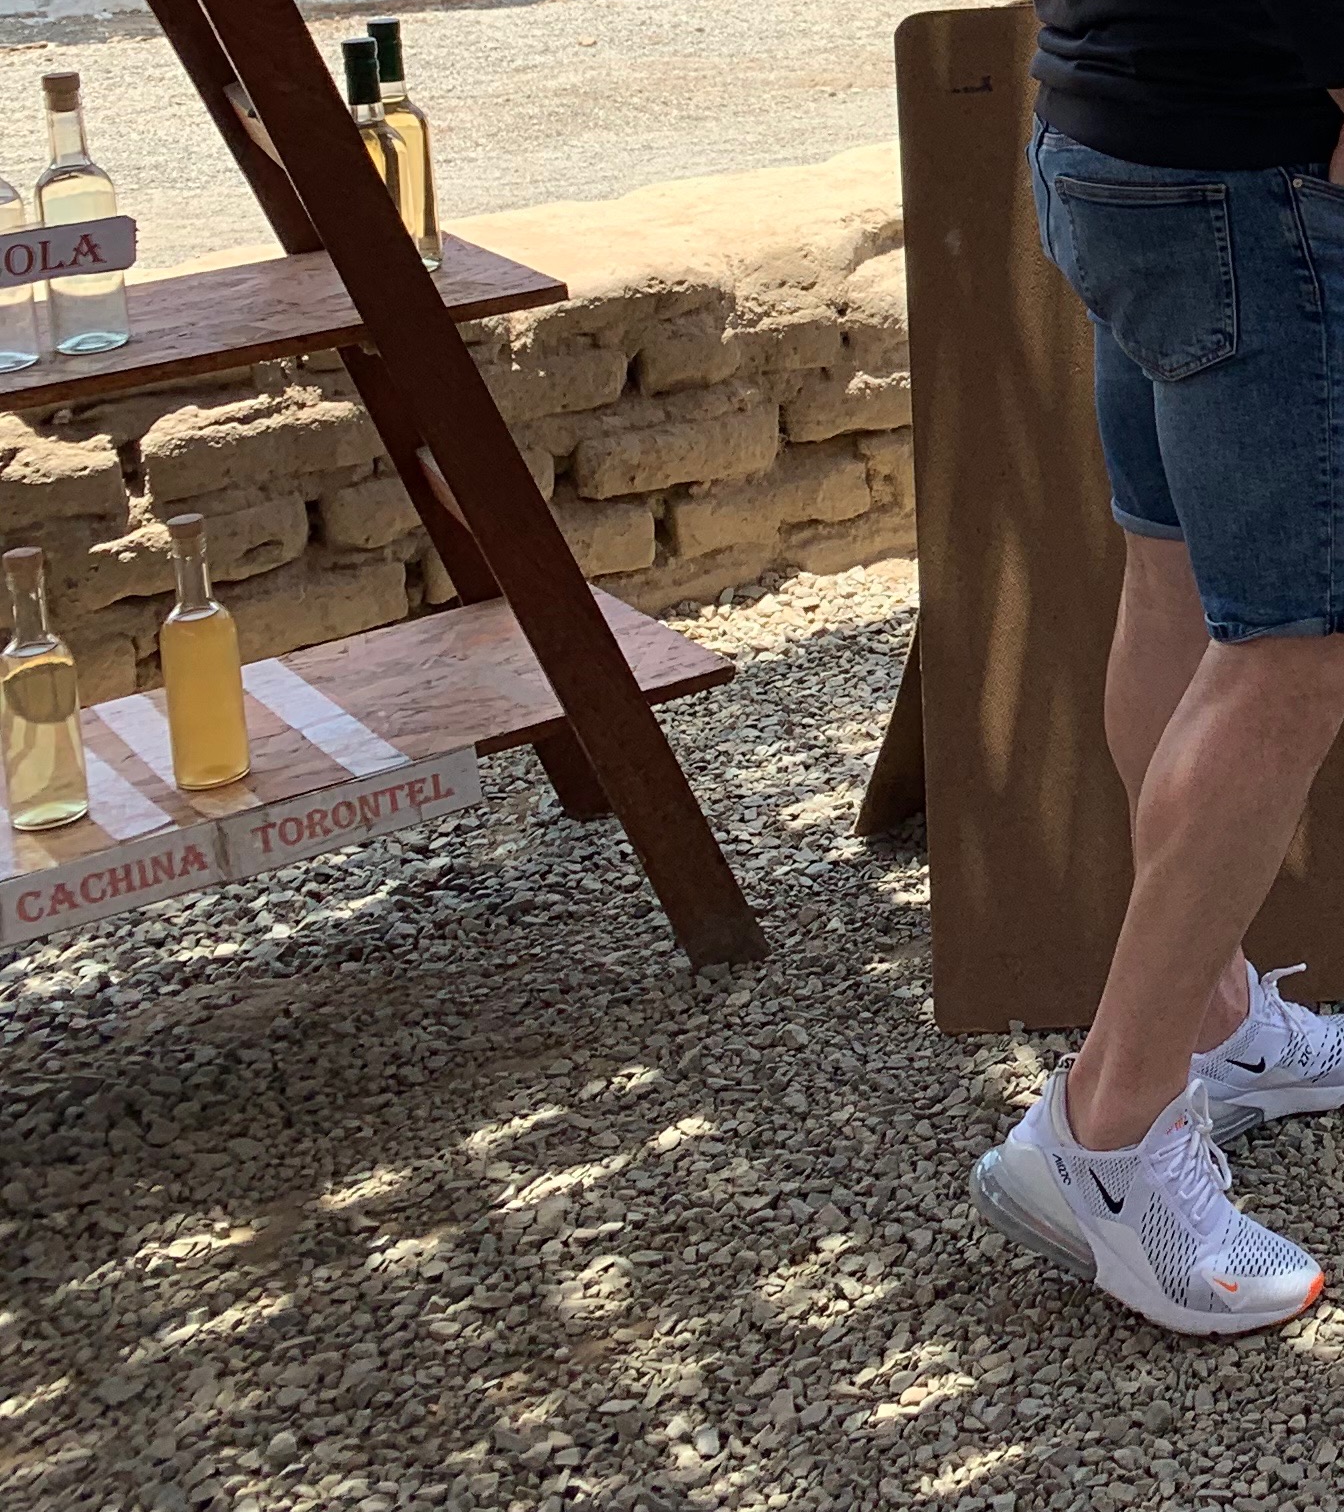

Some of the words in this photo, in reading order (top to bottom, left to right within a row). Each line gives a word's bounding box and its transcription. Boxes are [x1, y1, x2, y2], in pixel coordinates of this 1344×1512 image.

[0, 233, 108, 276] OLA
[251, 773, 456, 853] TORONTEL
[16, 844, 209, 923] CACHINA
